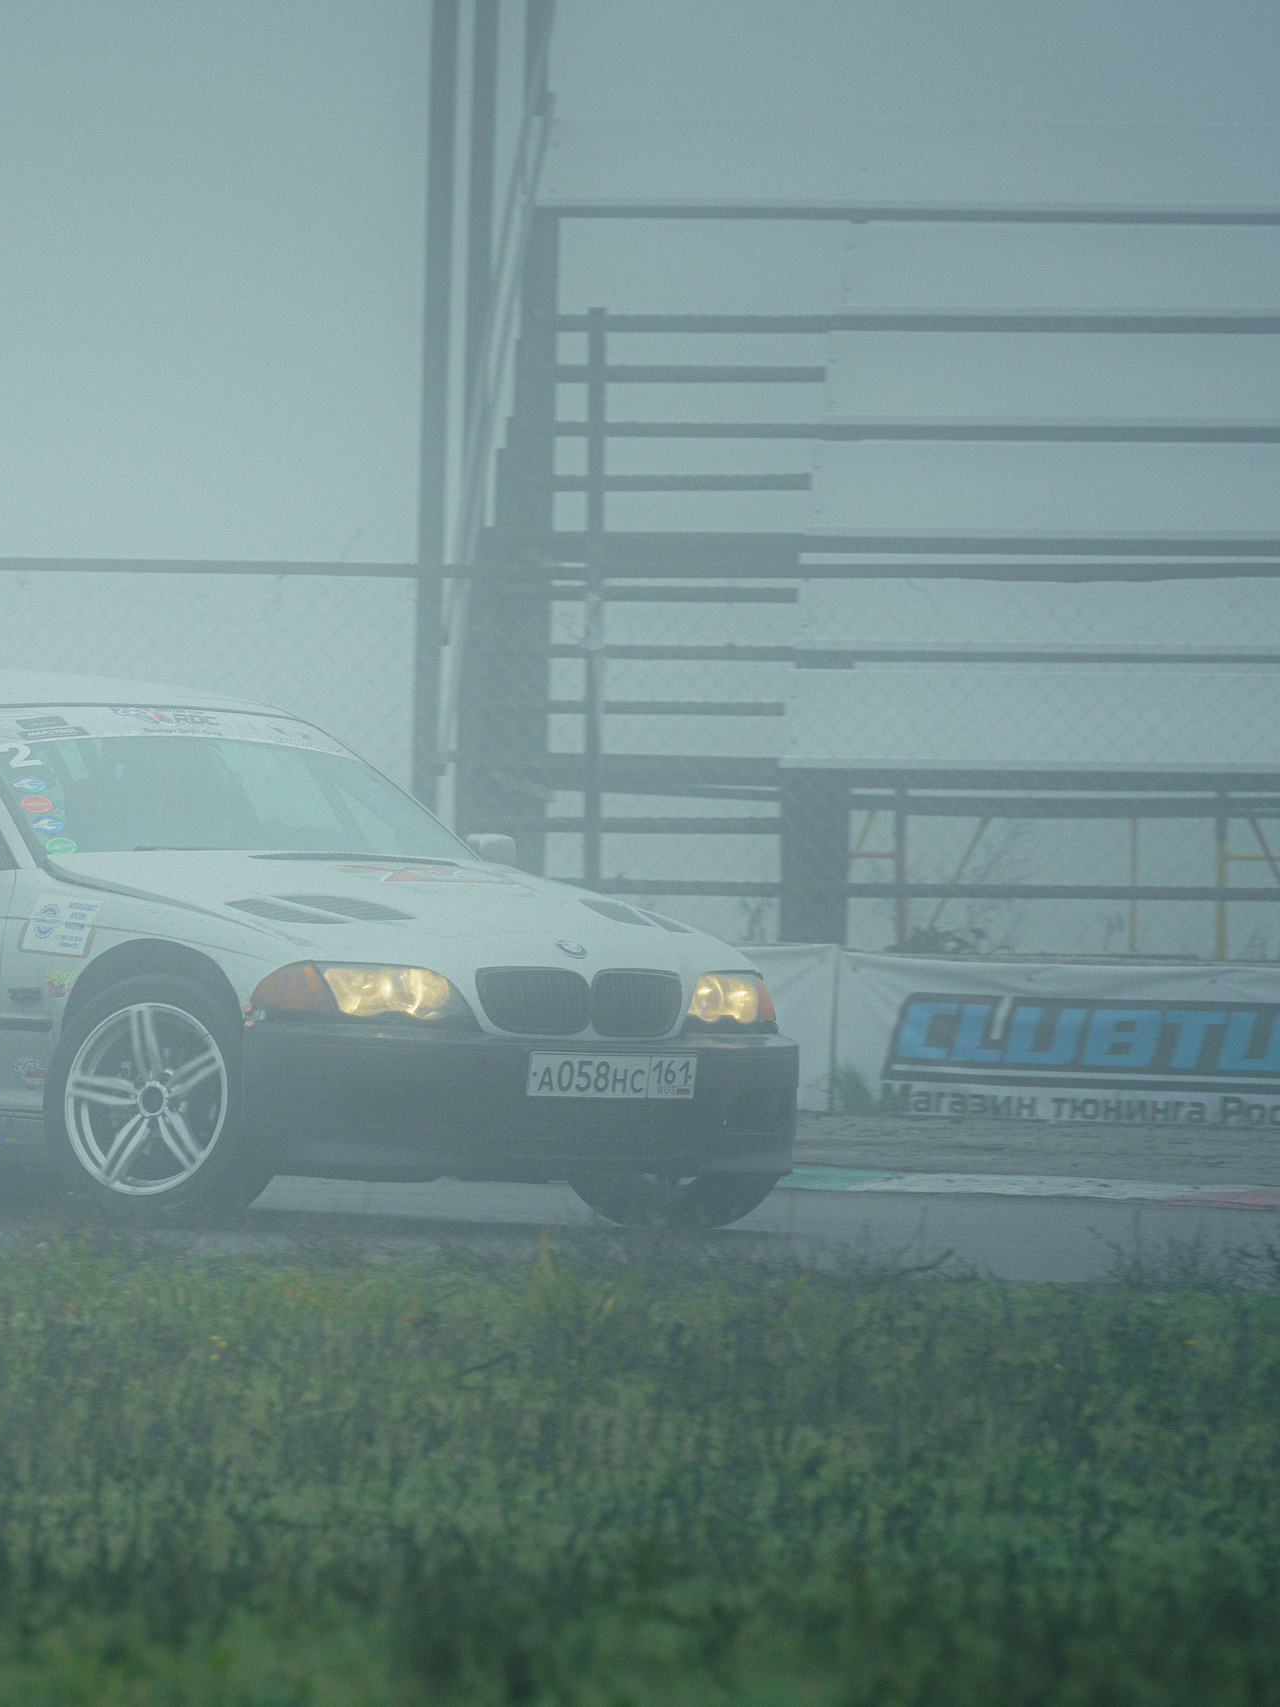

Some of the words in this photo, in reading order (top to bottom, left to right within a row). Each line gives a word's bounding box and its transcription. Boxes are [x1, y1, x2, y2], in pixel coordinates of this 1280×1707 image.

[26, 728, 80, 738] MAPETROL
[652, 1060, 691, 1087] 161
[657, 1084, 677, 1096] RUS
[880, 1082, 1036, 1118] Магазин
[1052, 1096, 1207, 1123] тюнинга
